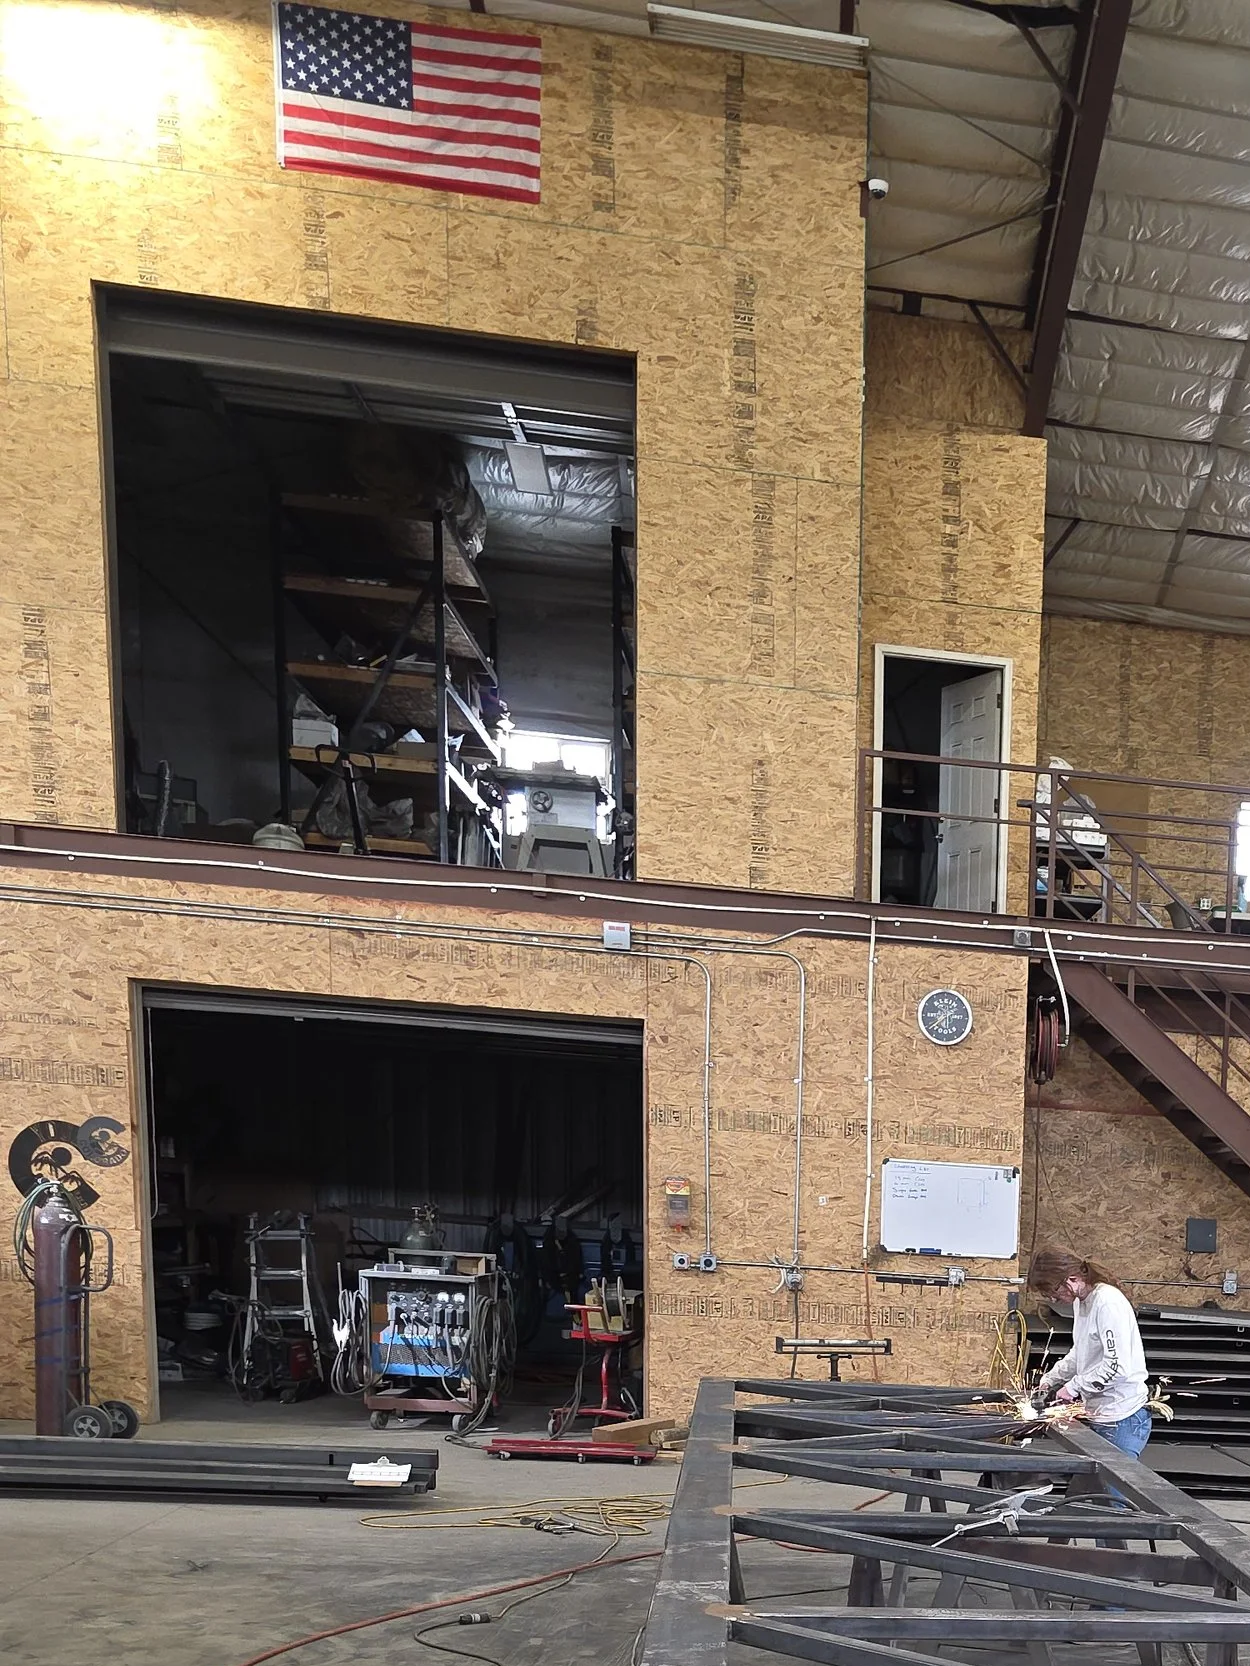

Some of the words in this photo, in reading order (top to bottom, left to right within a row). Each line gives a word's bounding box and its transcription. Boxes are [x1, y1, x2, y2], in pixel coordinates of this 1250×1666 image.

[33, 787, 54, 795] APA
[933, 998, 958, 1007] KLEIN
[933, 1025, 957, 1035] TOOLS
